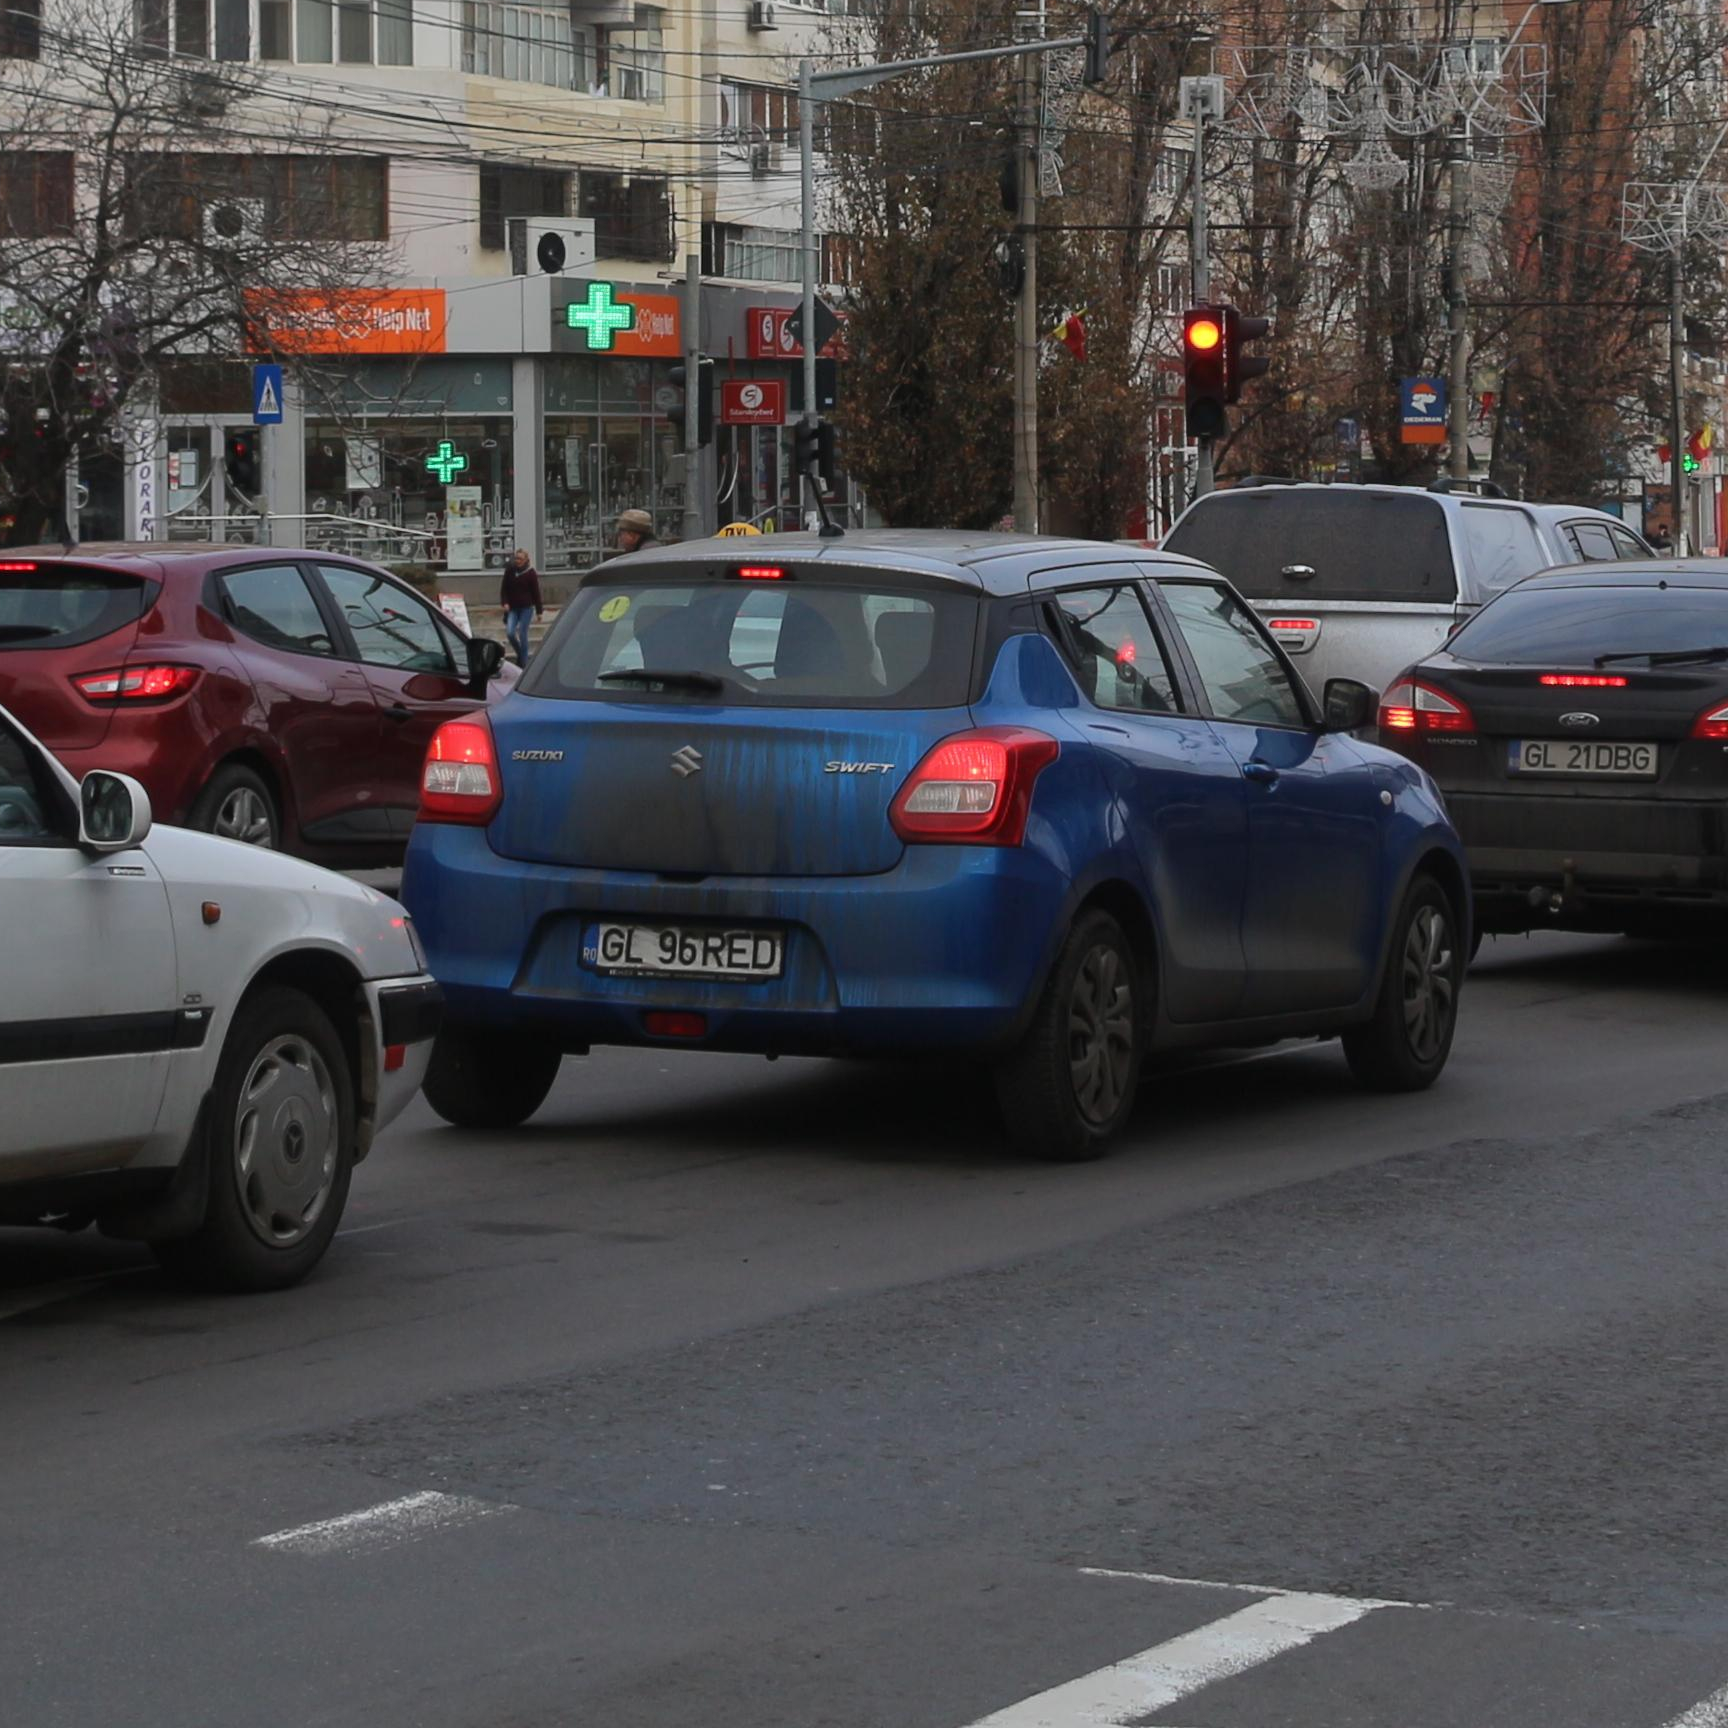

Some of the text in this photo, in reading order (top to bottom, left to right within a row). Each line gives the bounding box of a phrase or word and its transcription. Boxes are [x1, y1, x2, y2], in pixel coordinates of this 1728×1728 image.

[373, 306, 430, 334] Help Net
[512, 750, 563, 761] SUZUKI
[824, 760, 896, 774] SWIFT
